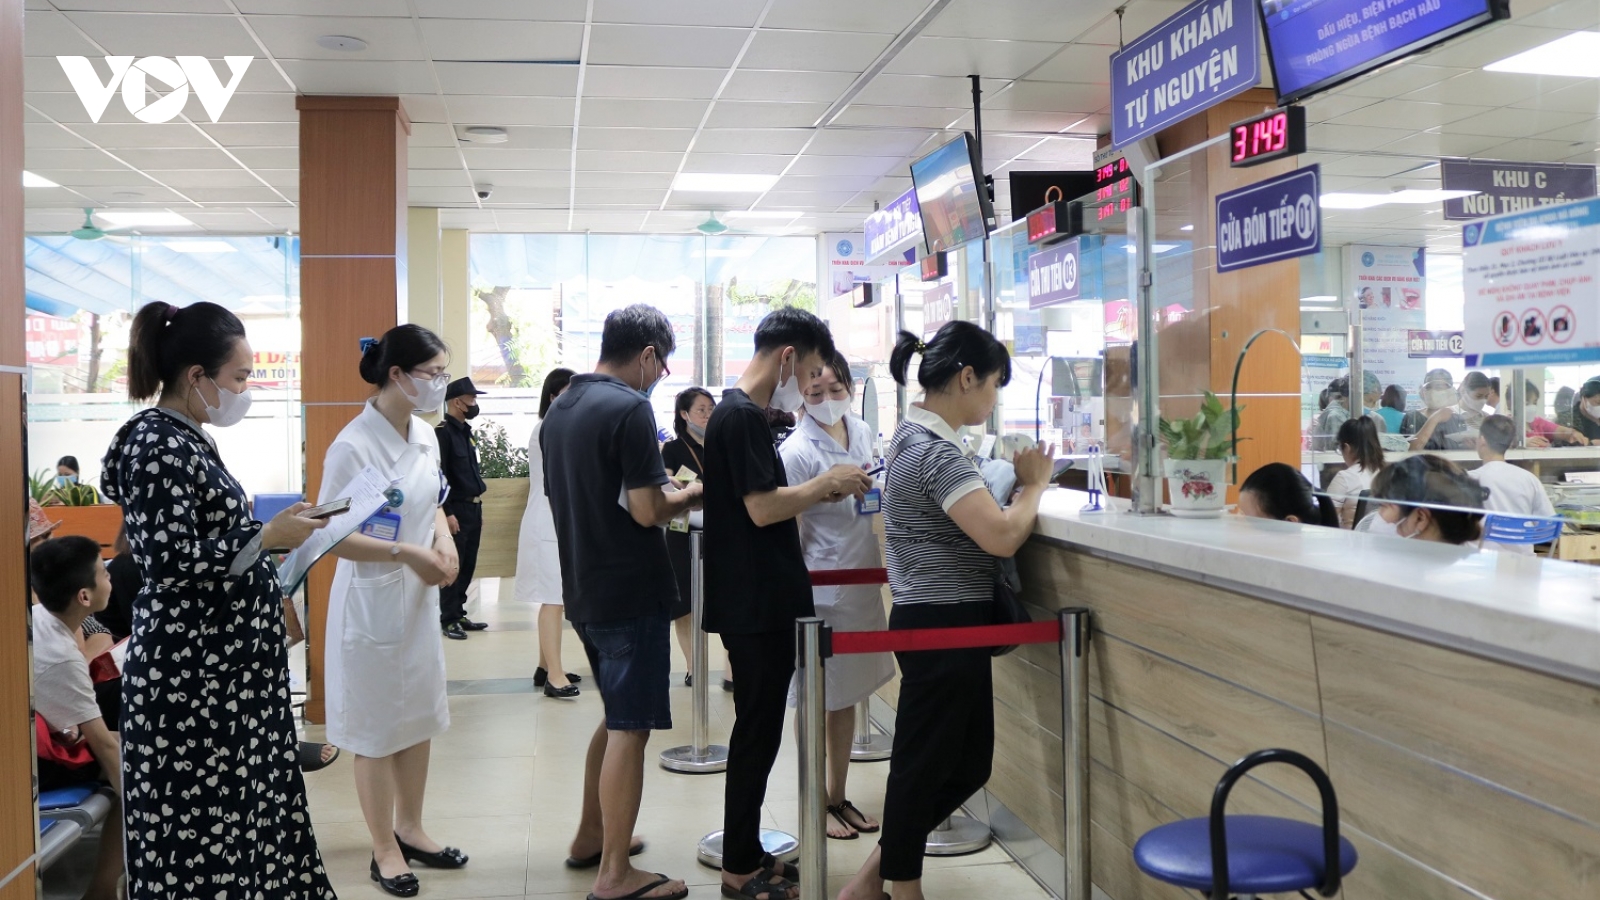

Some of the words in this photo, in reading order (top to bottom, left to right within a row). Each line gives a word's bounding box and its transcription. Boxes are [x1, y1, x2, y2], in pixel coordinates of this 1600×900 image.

[1361, 20, 1388, 41] BỆNH
[1389, 8, 1416, 29] BẠCH
[1127, 41, 1163, 86] KHU
[1170, 0, 1233, 61] KHÁM
[1125, 89, 1149, 129] TỰ
[1154, 45, 1238, 115] NGUYỆN
[1234, 112, 1287, 162] 3149
[1492, 170, 1529, 188] KHU
[1535, 171, 1548, 189] C
[1463, 194, 1496, 215] NƠI
[1220, 211, 1242, 252] CỬA
[1244, 207, 1267, 247] ĐÓN
[1269, 194, 1295, 241] TIẾP
[1299, 202, 1312, 234] 01
[1065, 259, 1075, 284] 03
[1452, 339, 1462, 350] 12
